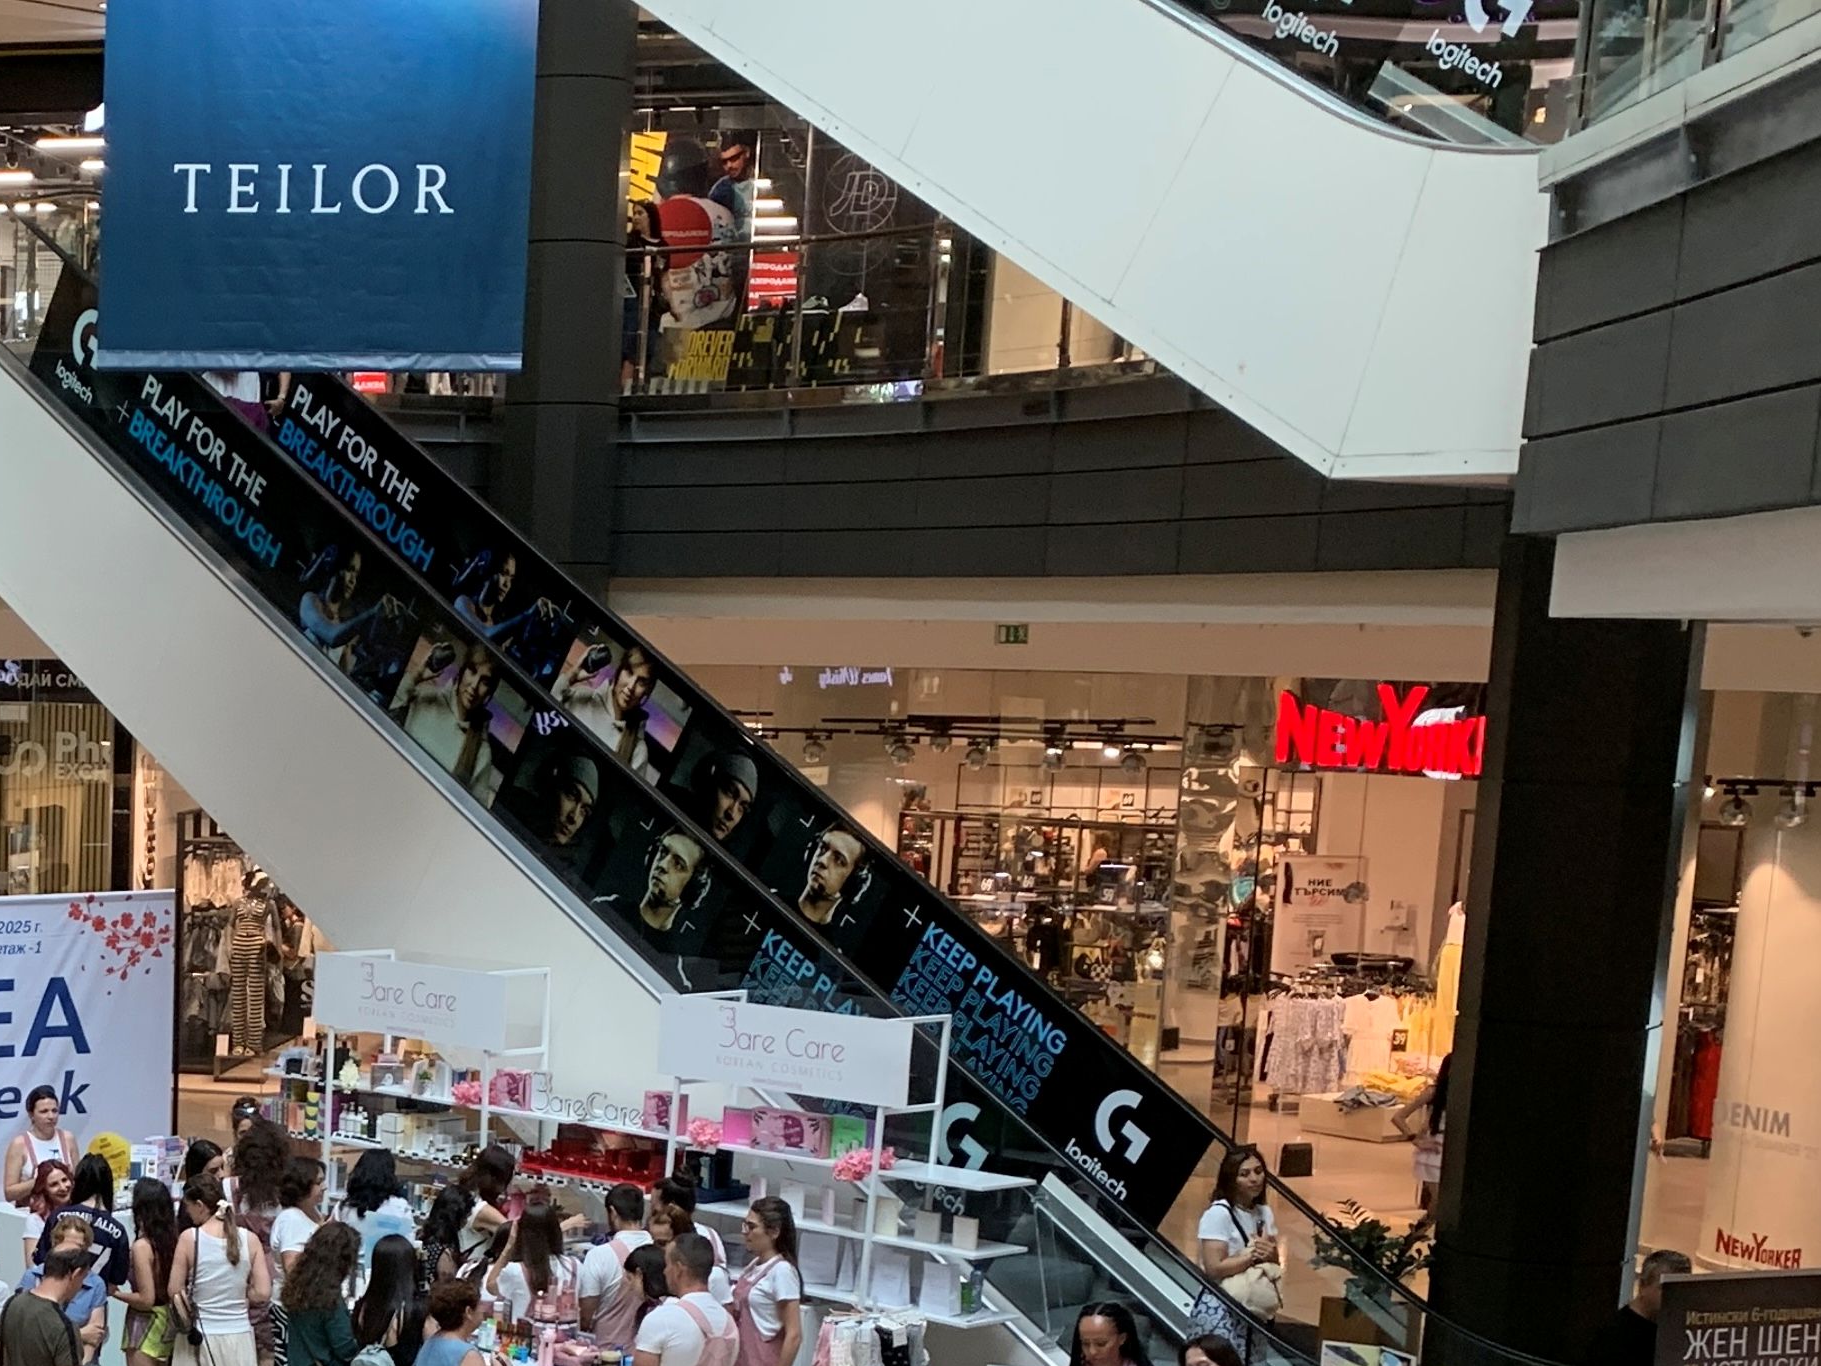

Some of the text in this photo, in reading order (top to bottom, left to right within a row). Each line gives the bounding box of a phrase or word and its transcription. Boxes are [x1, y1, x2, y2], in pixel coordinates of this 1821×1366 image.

[1261, 0, 1340, 58] logitech
[1425, 28, 1503, 89] logitech
[173, 163, 455, 214] TEILOR
[54, 358, 93, 405] logitech
[140, 374, 268, 508] PLAY FOR THE
[290, 383, 420, 513] PLAY FOR THE
[128, 408, 283, 568] BREAKTHROUGH
[278, 417, 436, 572] BREAKTHROUGH
[1307, 878, 1333, 888] НИЕ
[762, 927, 816, 978] KEEP
[411, 981, 458, 1012] Care
[909, 943, 1055, 1077] KEEP PLAYING
[921, 920, 1067, 1055] KEEP PLAYING
[785, 1028, 845, 1064] Care
[897, 966, 1042, 1101] KEEP PLAYING
[1683, 1322, 1821, 1361] ЖЕН ШЕН
[1686, 1310, 1749, 1326] Истински
